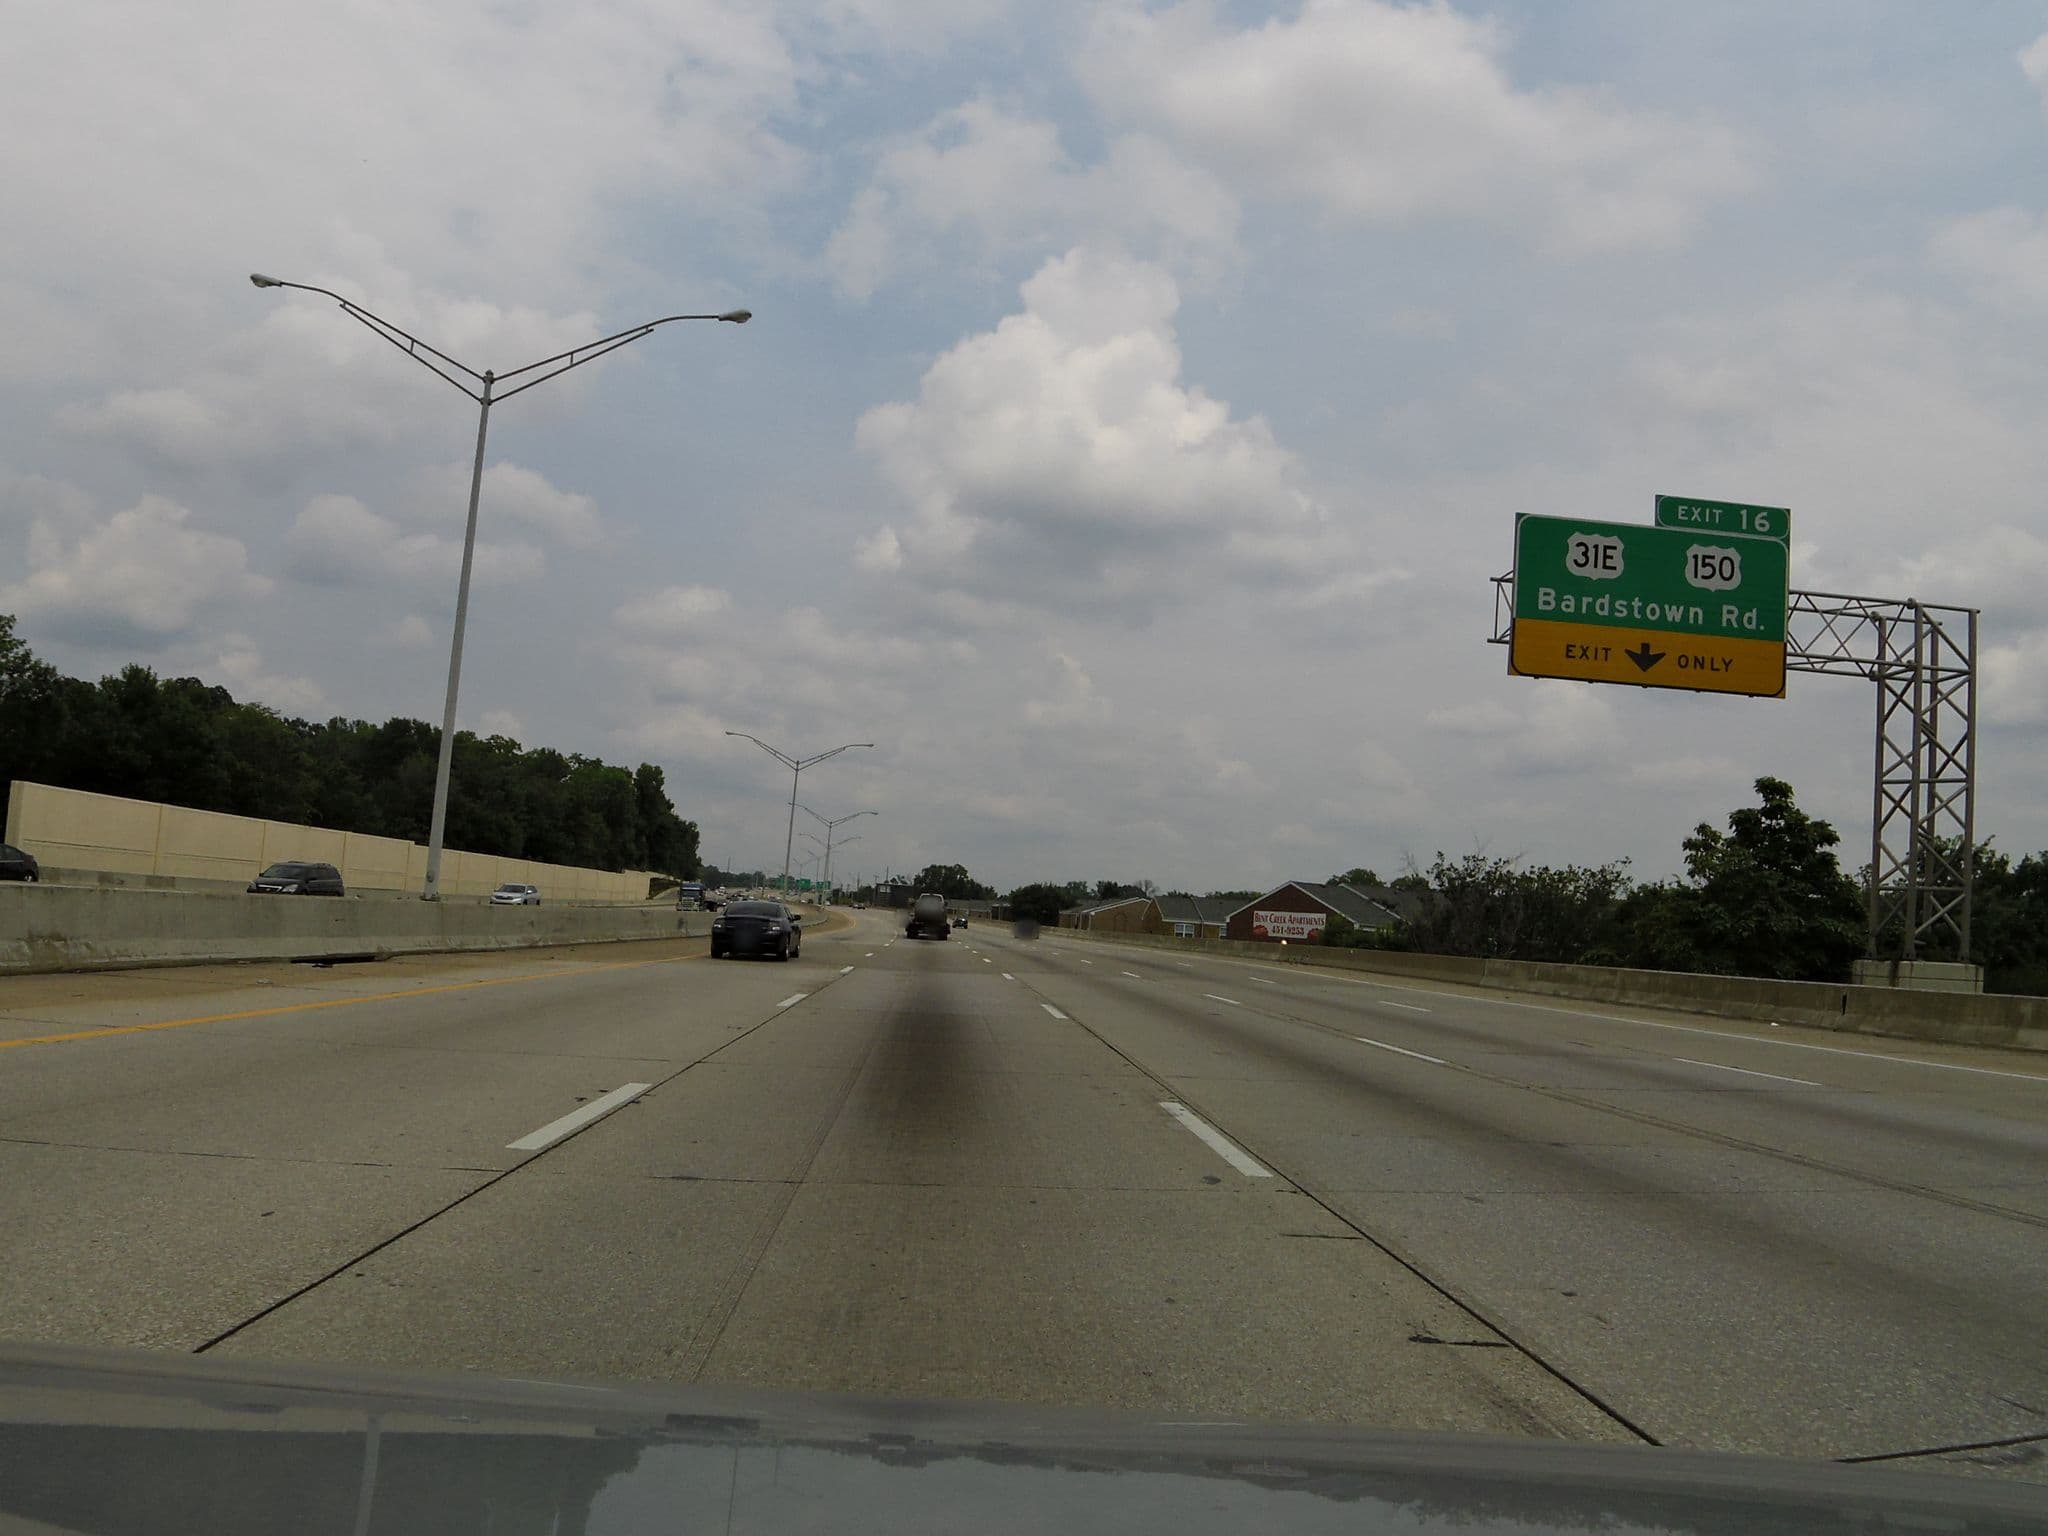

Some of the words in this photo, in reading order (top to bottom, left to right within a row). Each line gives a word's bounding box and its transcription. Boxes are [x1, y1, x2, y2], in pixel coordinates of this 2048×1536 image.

[1678, 505, 1723, 524] EXIT
[1740, 509, 1770, 532] 16
[1572, 542, 1618, 571] 31E
[1691, 554, 1735, 581] 150
[1537, 587, 1703, 625] Bardstown
[1721, 607, 1765, 631] Rd.
[1565, 644, 1612, 662] EXIT
[1678, 654, 1733, 672] ONLY
